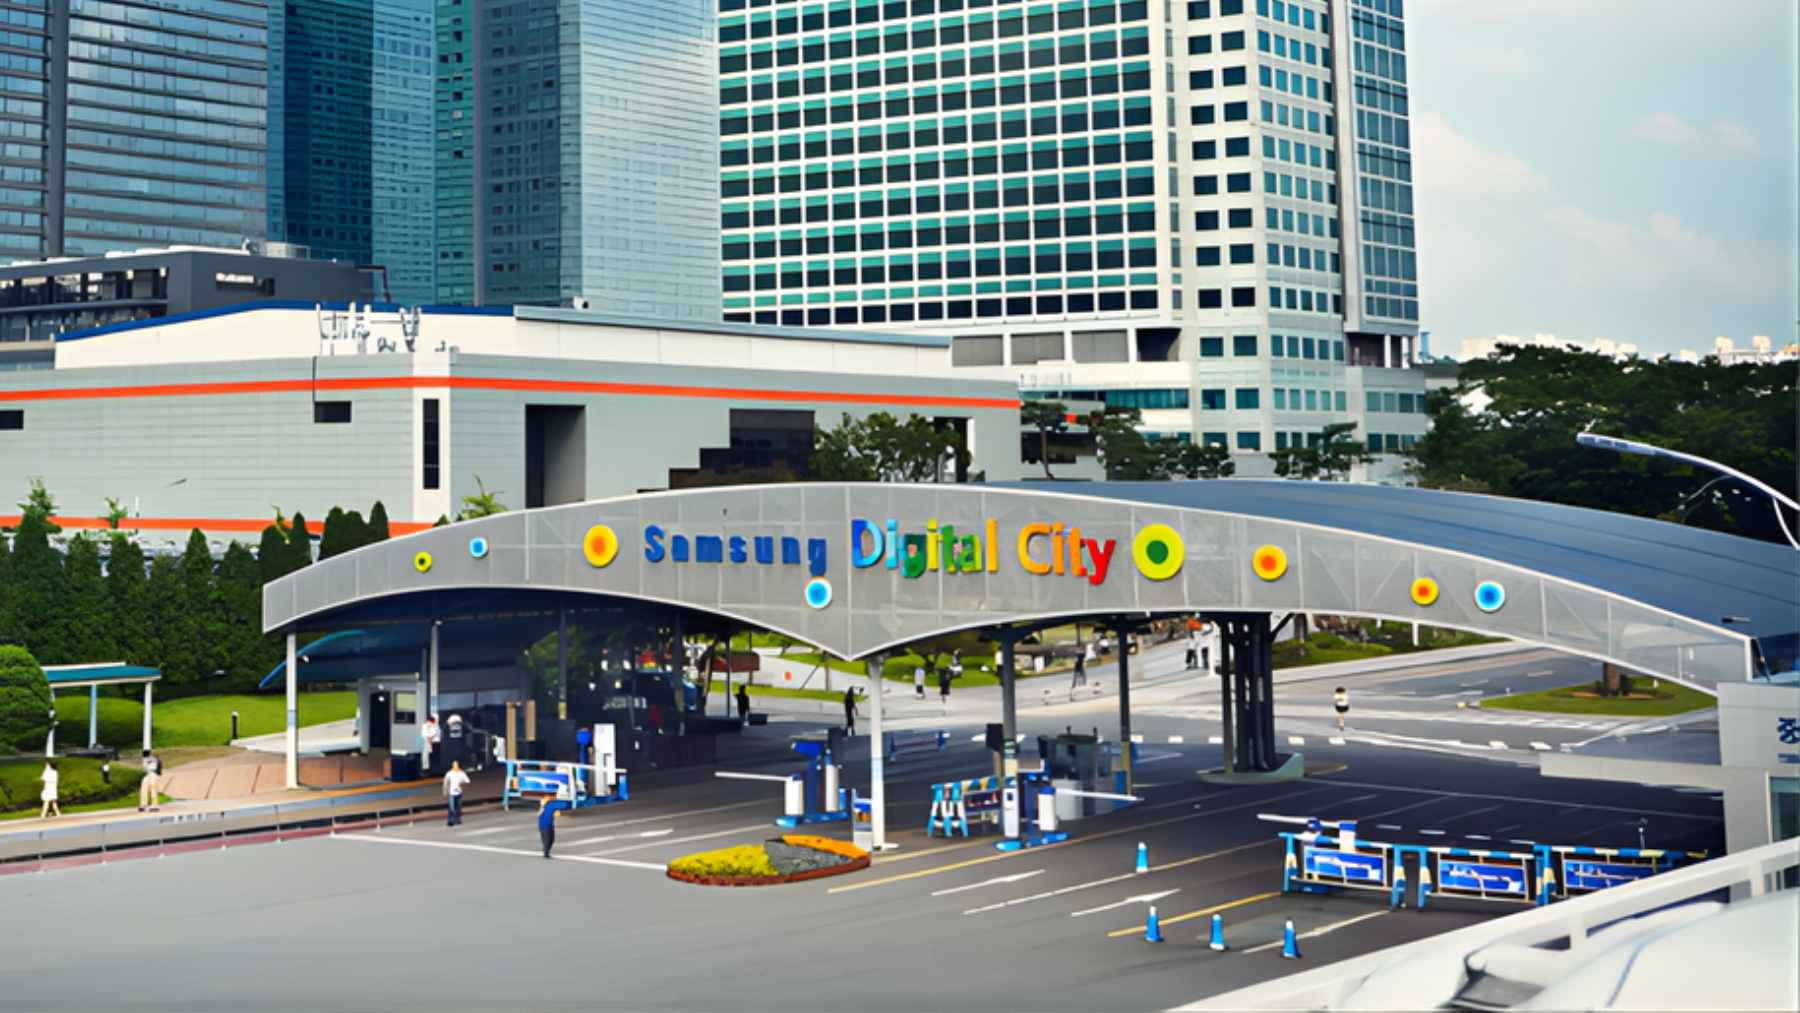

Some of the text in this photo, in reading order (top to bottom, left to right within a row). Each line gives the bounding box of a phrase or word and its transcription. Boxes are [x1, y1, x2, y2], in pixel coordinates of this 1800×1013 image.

[644, 517, 1117, 586] Samsung Digital City
